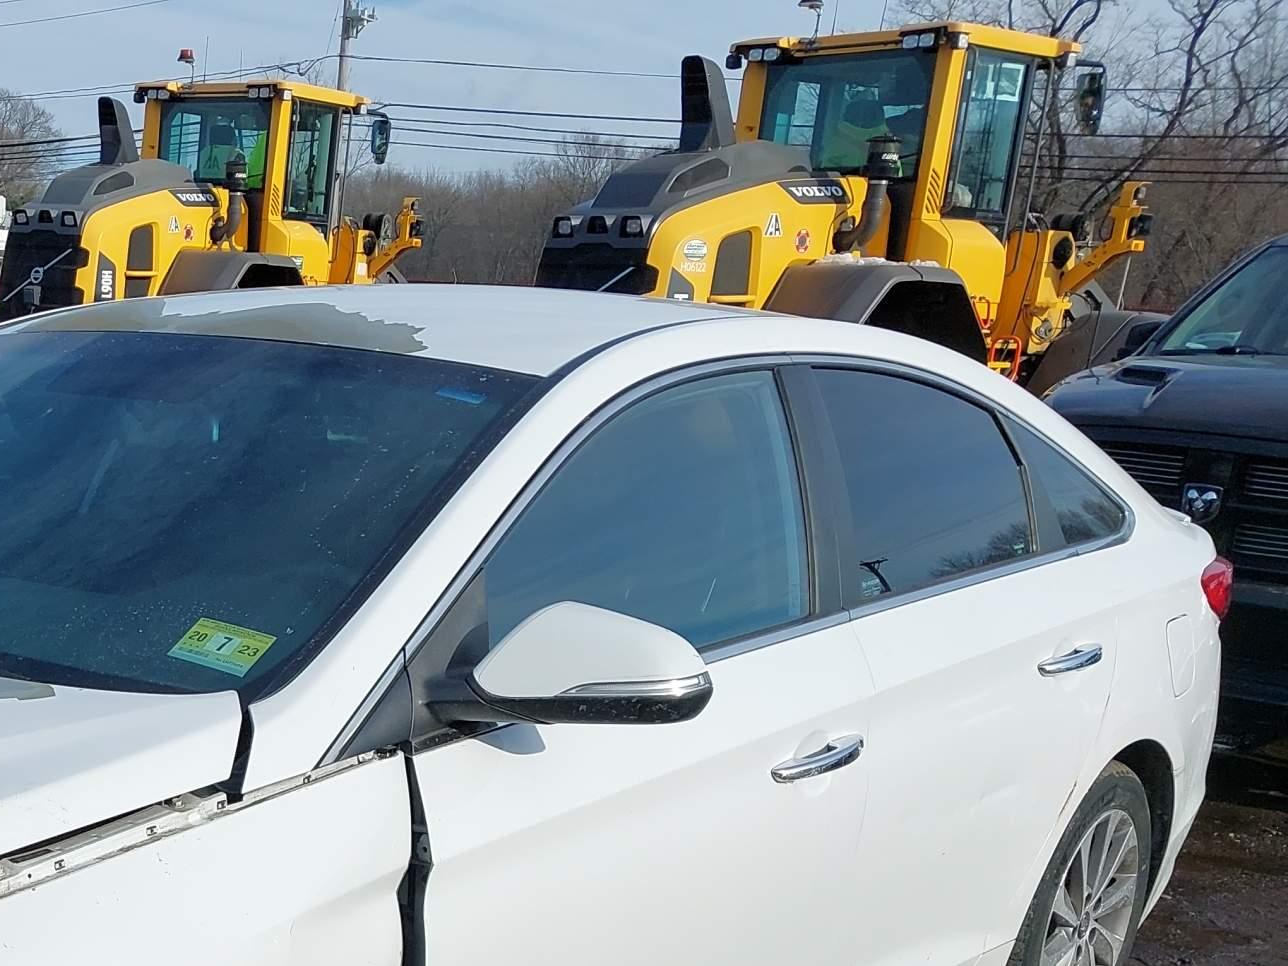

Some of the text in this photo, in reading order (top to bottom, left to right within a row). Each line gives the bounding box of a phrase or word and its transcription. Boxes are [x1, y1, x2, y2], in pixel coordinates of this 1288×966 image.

[788, 185, 843, 197] VOLVO
[176, 193, 215, 202] VOLVO
[680, 261, 707, 273] H06122
[101, 270, 113, 299] L90H
[188, 630, 208, 643] 20
[215, 636, 233, 652] 7
[238, 645, 260, 657] 23
